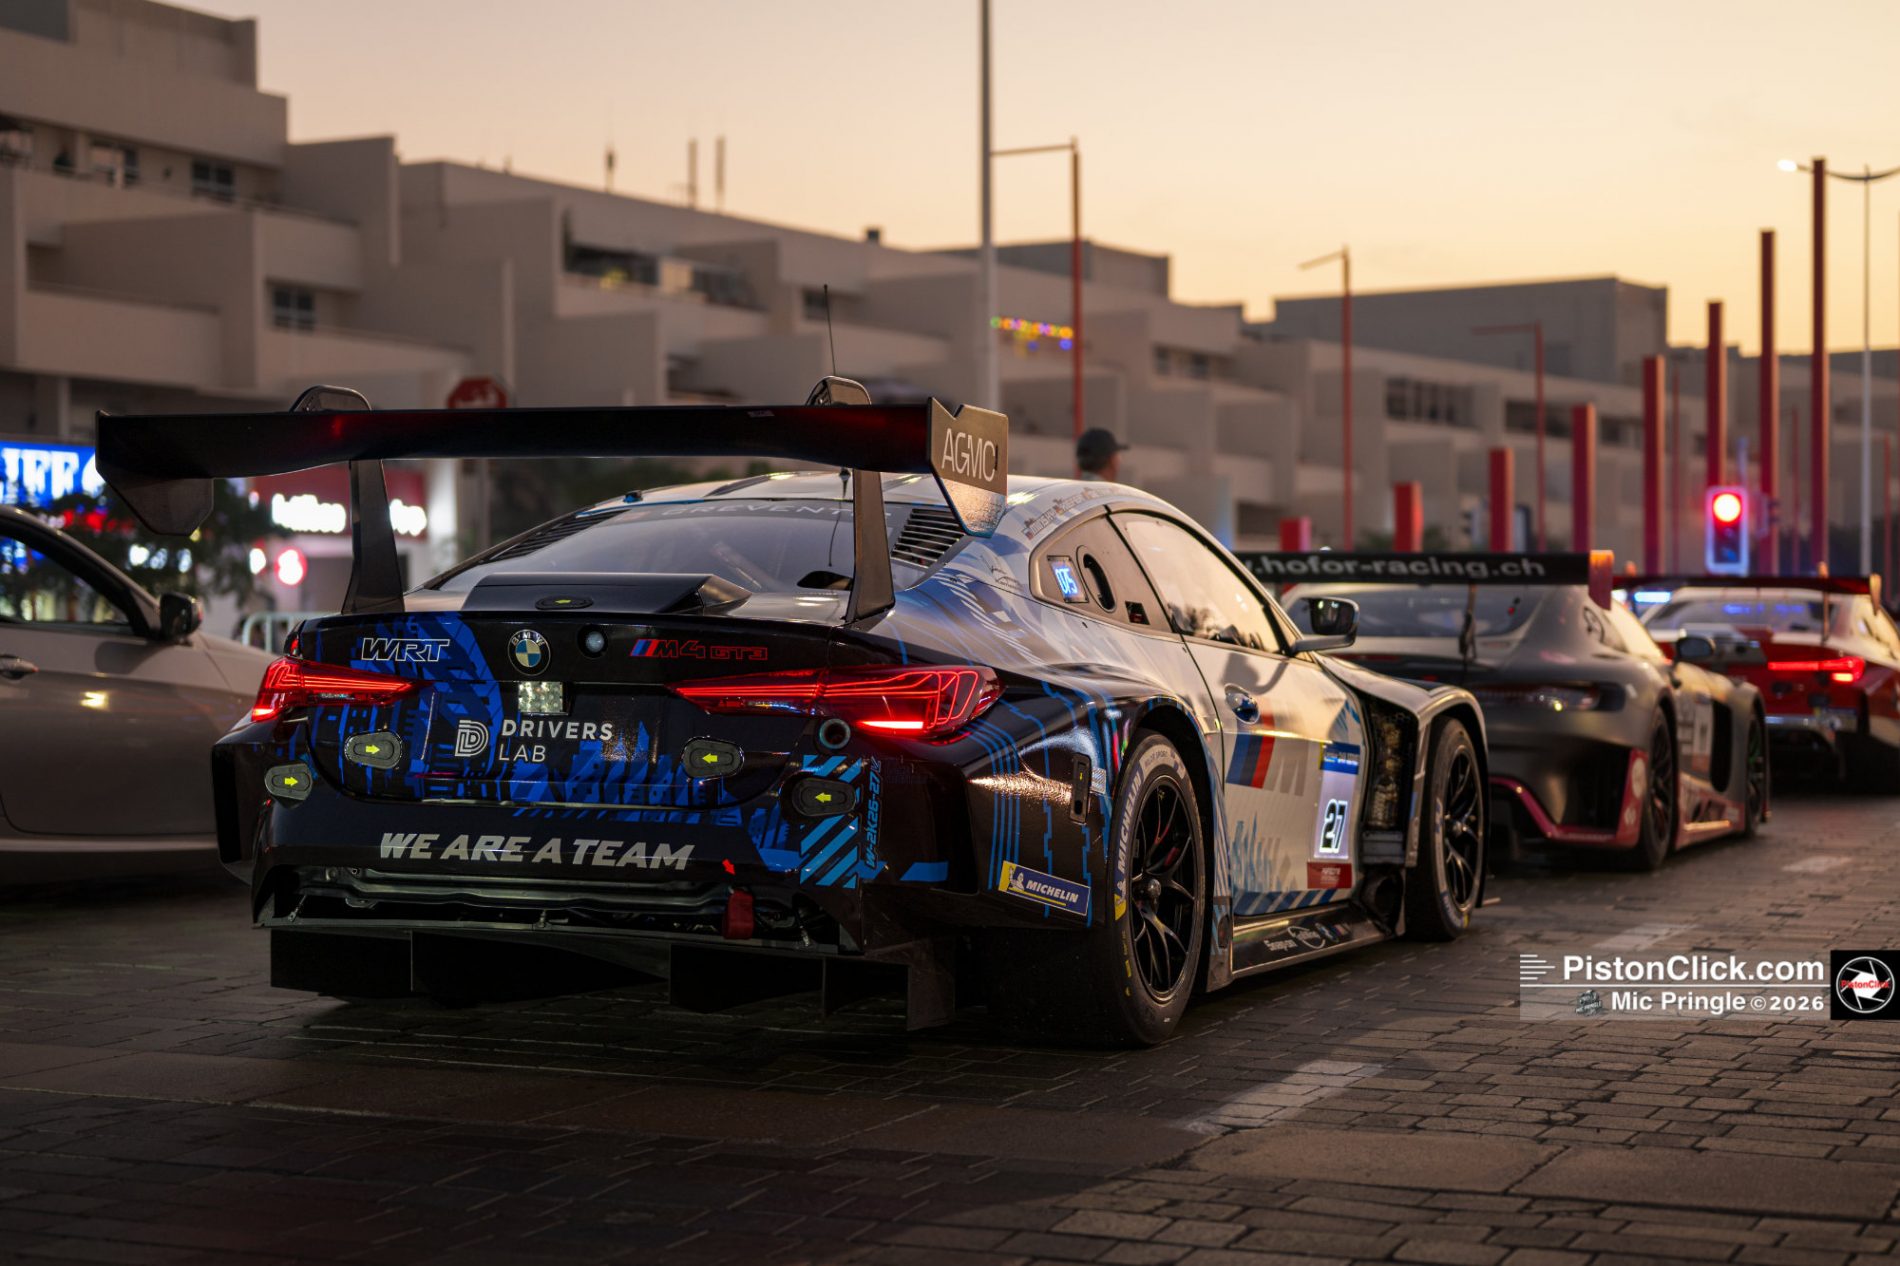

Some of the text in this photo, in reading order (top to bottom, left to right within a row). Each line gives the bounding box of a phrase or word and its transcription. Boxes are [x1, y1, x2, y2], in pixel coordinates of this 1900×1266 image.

[941, 427, 995, 482] AGMC
[1246, 556, 1545, 578] .hofor-racing.ch
[361, 638, 450, 662] WRT
[710, 645, 768, 660] GT3
[502, 719, 613, 741] DRIVERS
[499, 743, 546, 762] LAB
[1118, 770, 1143, 873] MICHELIN
[1319, 799, 1348, 853] 27
[380, 832, 695, 871] WE ARE A TEAM
[1026, 880, 1079, 903] MICHELIN
